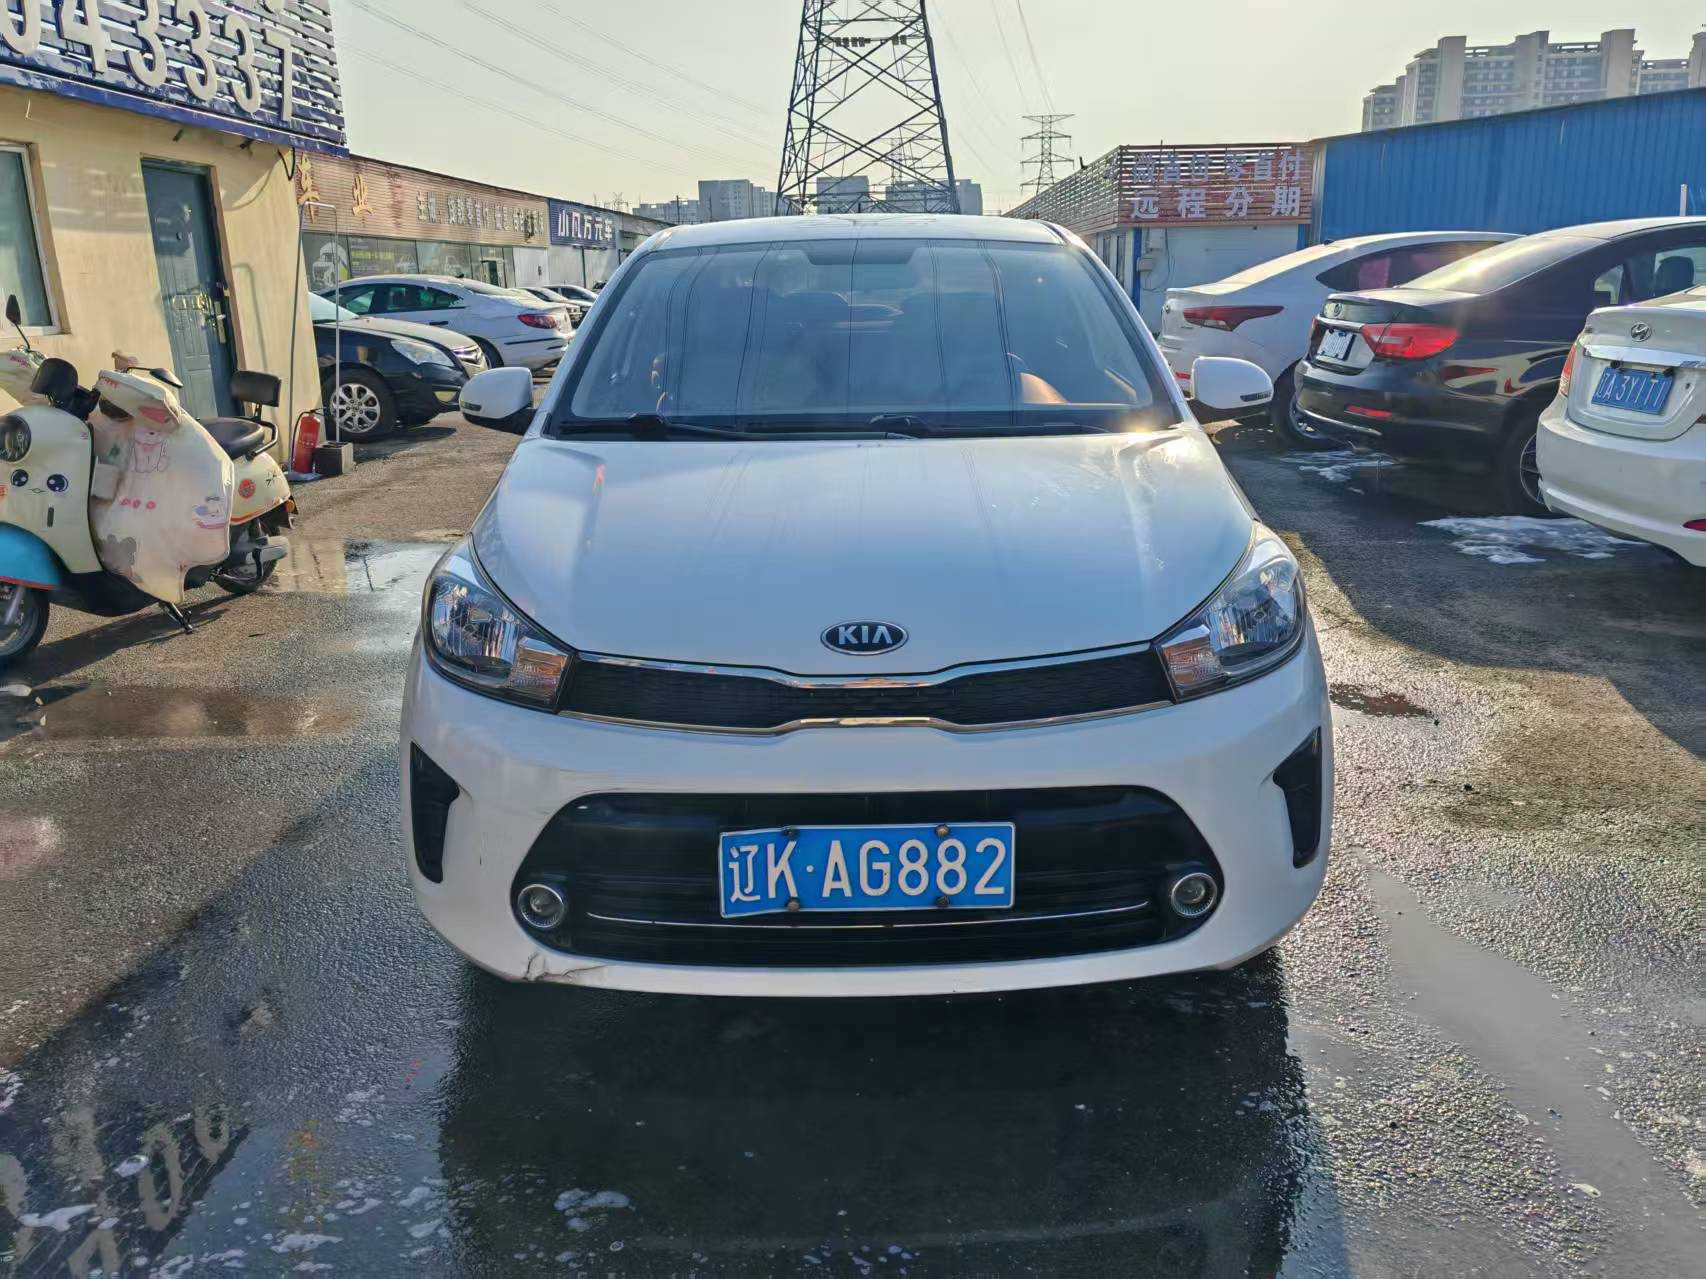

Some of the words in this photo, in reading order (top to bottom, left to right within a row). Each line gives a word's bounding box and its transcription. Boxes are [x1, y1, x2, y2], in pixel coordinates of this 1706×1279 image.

[1131, 186, 1300, 219] 远程分期
[838, 625, 893, 644] KIA
[728, 837, 1006, 903] 辽K·AG882
